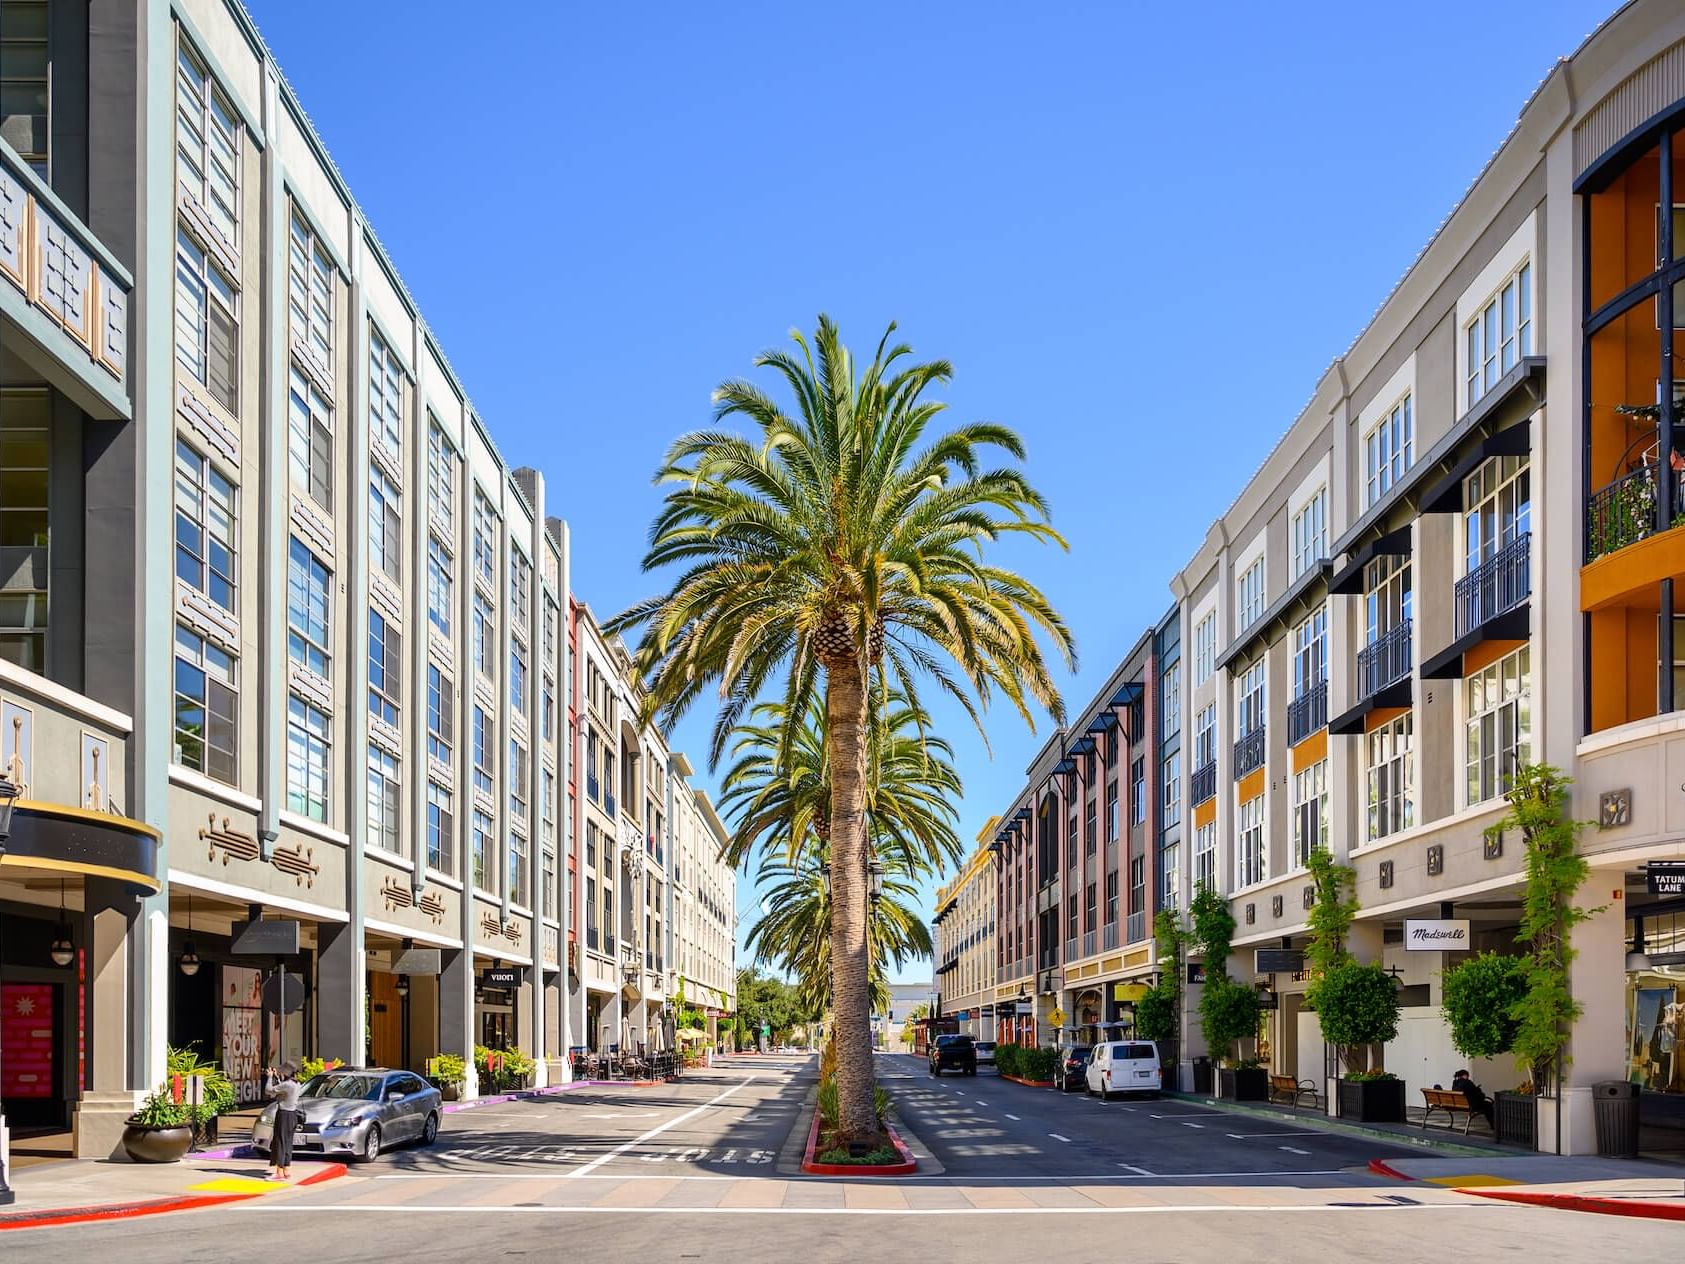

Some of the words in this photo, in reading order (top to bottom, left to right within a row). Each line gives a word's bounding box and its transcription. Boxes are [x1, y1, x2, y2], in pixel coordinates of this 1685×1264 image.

[1654, 875, 1685, 884] TATUM
[1658, 884, 1682, 892] LANE
[224, 1009, 254, 1035] MEET
[224, 1035, 259, 1058] YOUR
[224, 1058, 254, 1081] NEW
[234, 1080, 262, 1104] EIGH
